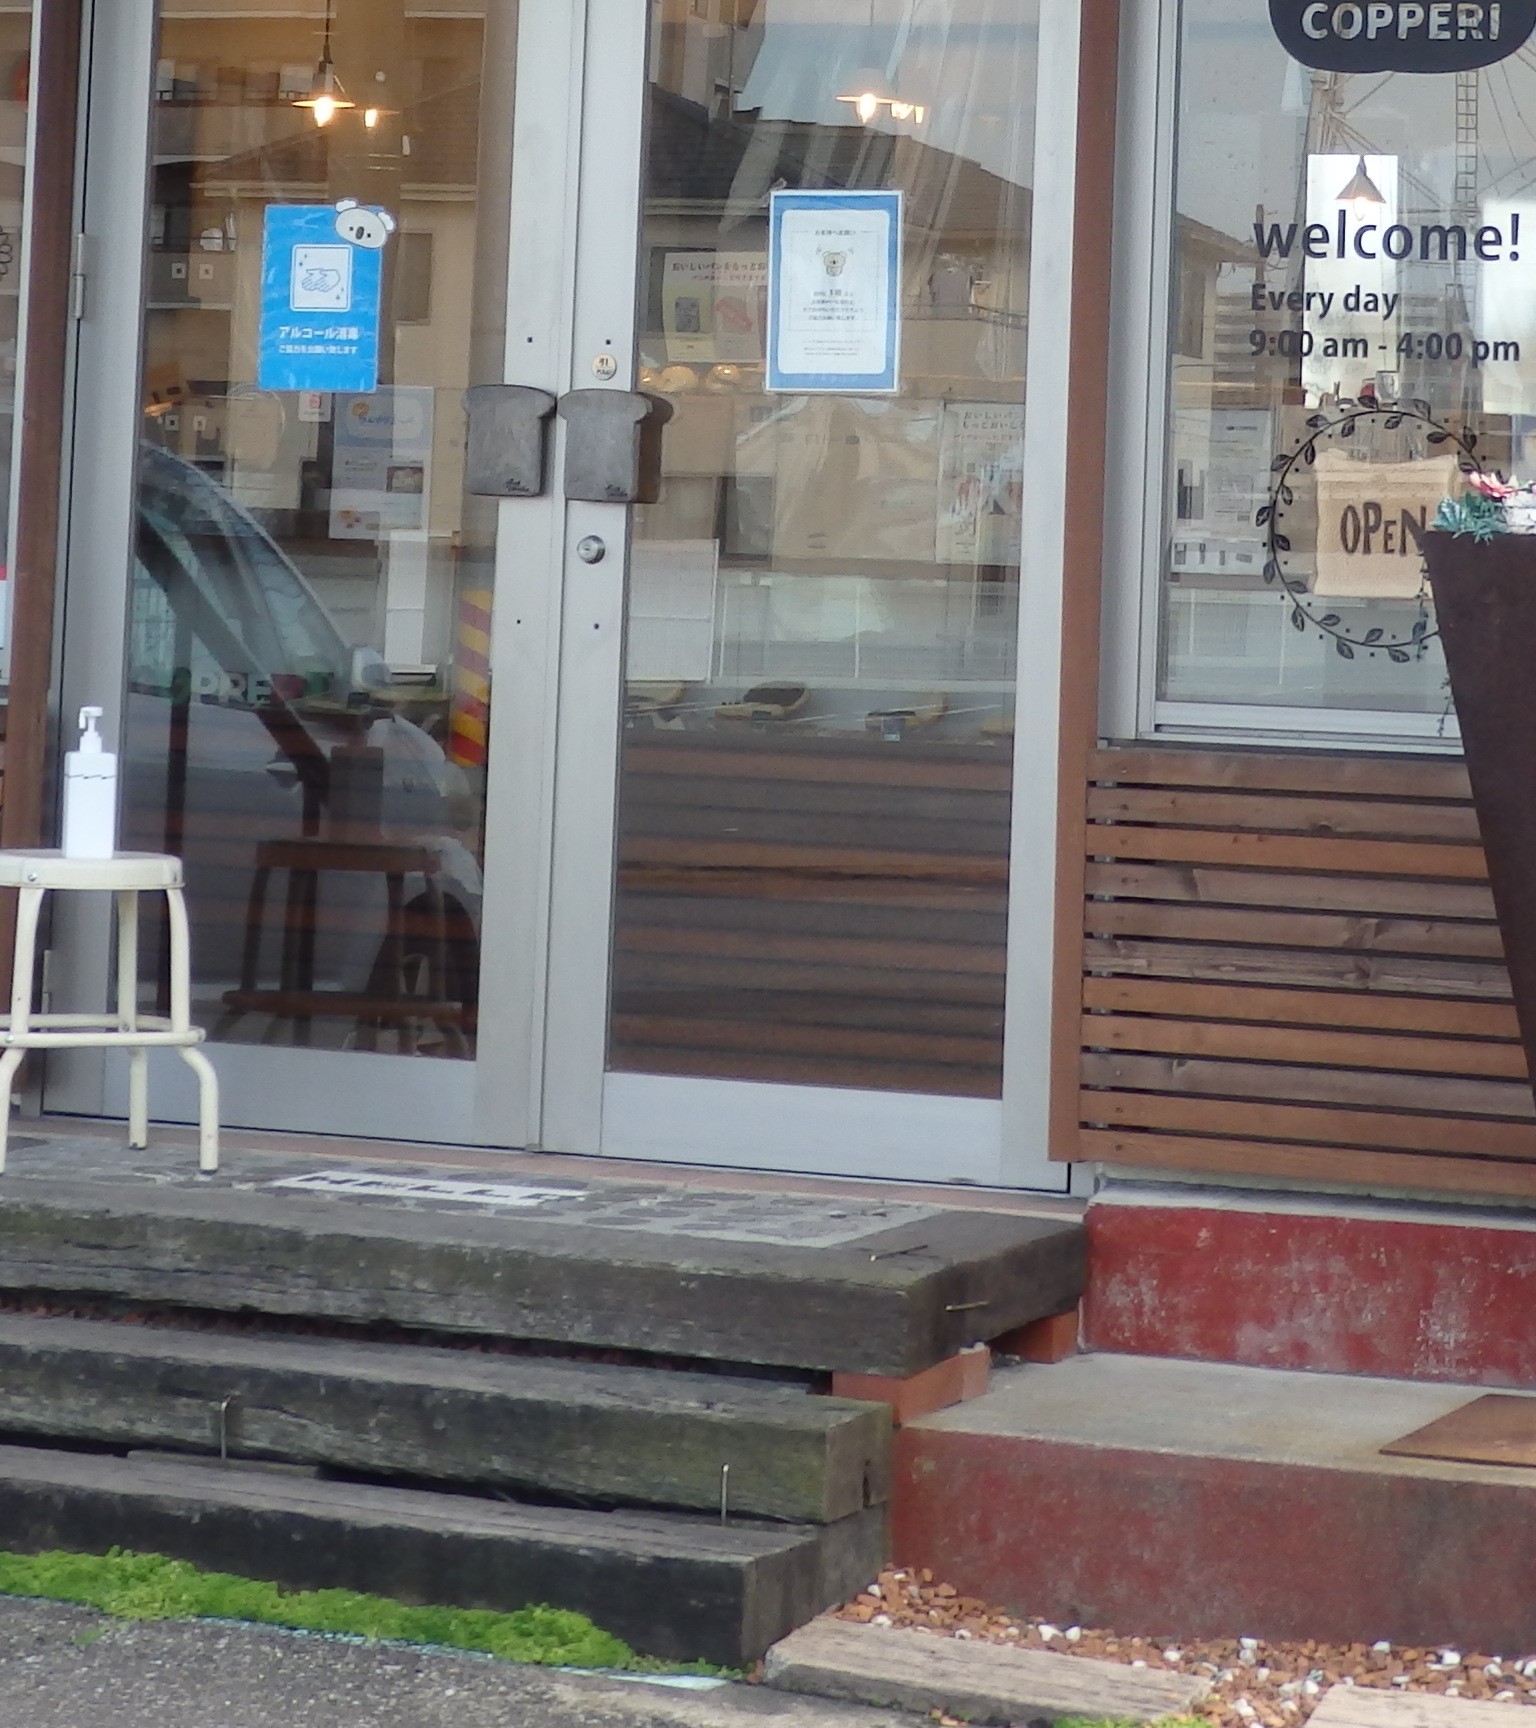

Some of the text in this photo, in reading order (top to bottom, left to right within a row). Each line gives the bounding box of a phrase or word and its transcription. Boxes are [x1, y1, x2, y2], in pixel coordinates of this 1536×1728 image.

[1301, 2, 1502, 41] COPPERI
[1252, 209, 1521, 262] welcome!
[1250, 283, 1400, 321] Every day
[1249, 330, 1315, 359] 9:00
[1323, 336, 1368, 359] am
[1396, 332, 1463, 360] 4:00
[1471, 338, 1521, 372] pm
[1340, 501, 1427, 556] OPEN
